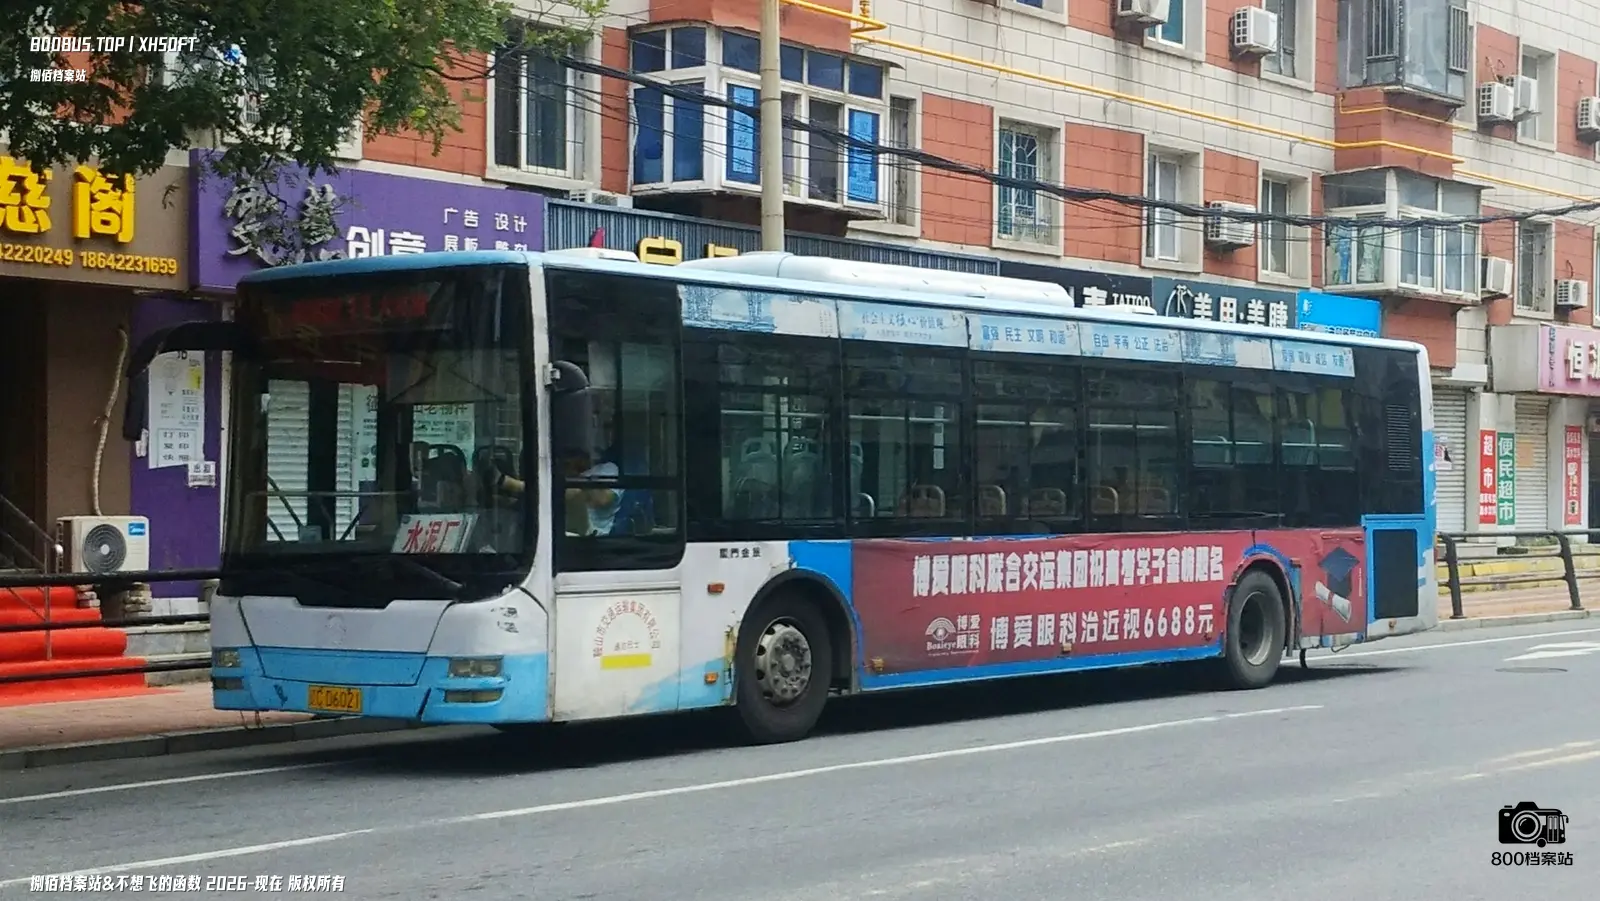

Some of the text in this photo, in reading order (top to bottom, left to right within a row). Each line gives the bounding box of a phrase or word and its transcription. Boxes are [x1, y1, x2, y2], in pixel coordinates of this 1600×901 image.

[443, 207, 528, 233] 广告 设计
[0, 243, 178, 275] 2220249 18642231659
[982, 324, 999, 341] 富强
[1005, 326, 1022, 342] 民主
[1027, 328, 1044, 343] 文明
[1093, 333, 1109, 348] 自由
[1134, 336, 1149, 350] 公正
[1483, 435, 1493, 488] 超市
[1498, 437, 1514, 521] 便民超市
[402, 519, 460, 552] 水泥厂
[957, 614, 980, 631] 博爱
[989, 603, 1214, 650] 博爱眼科治近视6688元
